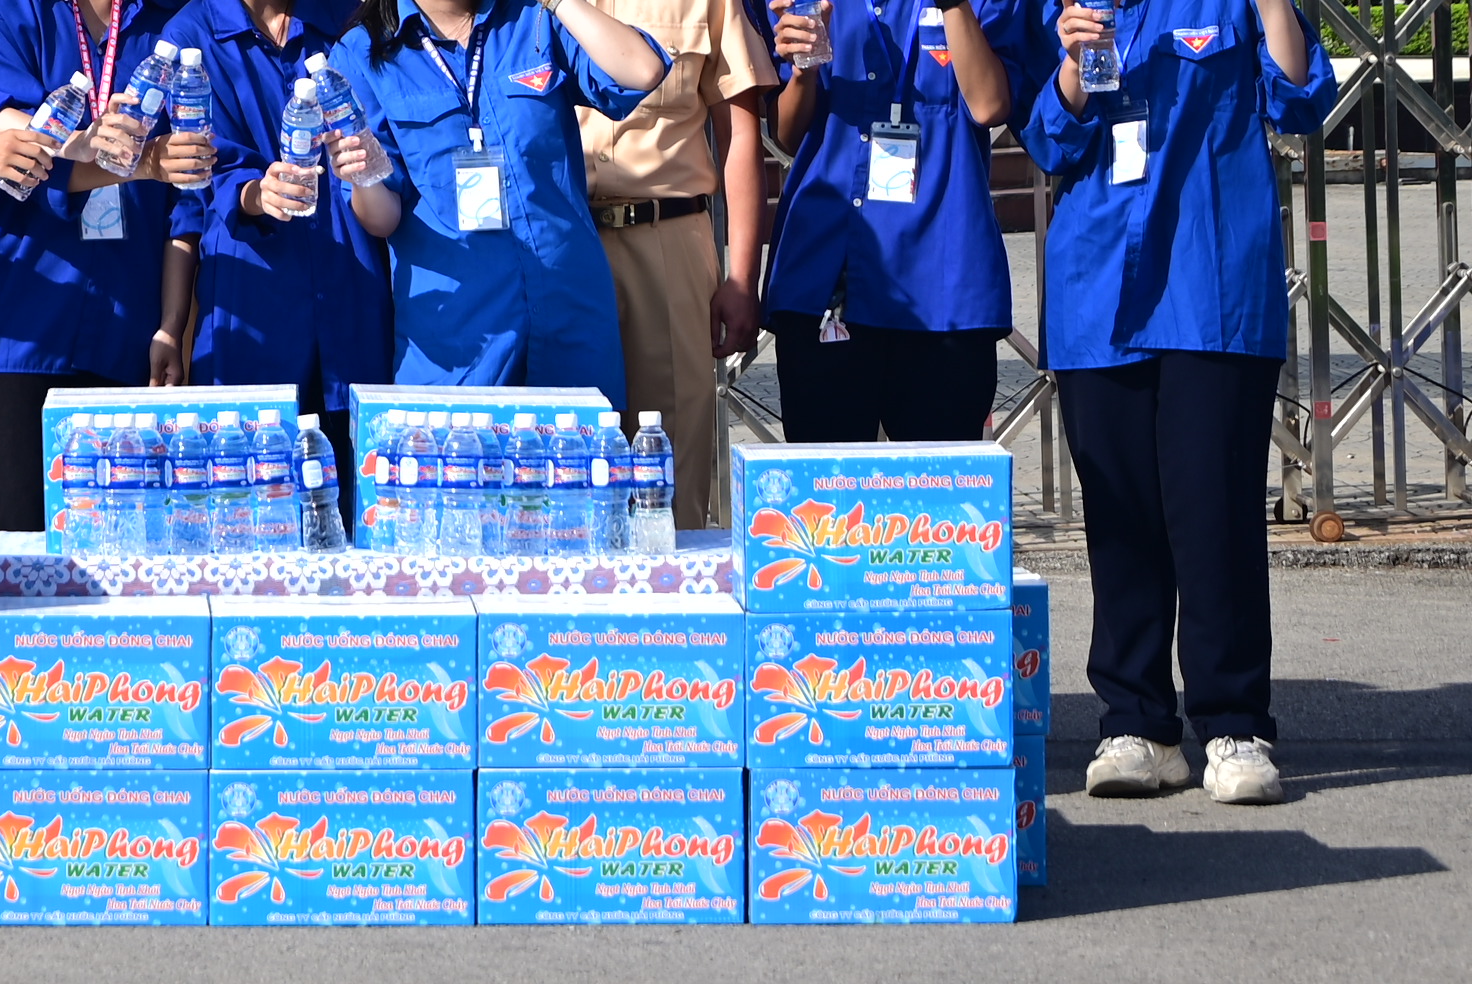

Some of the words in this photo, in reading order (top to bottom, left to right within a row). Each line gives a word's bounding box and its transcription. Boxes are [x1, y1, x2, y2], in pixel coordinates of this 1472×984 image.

[813, 474, 856, 490] NƯỚC
[860, 472, 903, 489] UỐNG
[908, 472, 951, 489] ĐÓNG
[956, 473, 992, 488] CHAI
[813, 513, 1002, 553] HaiPhong
[869, 548, 952, 565] WATER
[15, 631, 57, 647] NƯỚC
[61, 630, 104, 647] UỐNG
[109, 632, 152, 647] ĐÓNG
[156, 633, 192, 647] CHAI
[281, 632, 324, 648] NƯỚC
[327, 631, 370, 648] UỐNG
[375, 632, 418, 647] ĐÓNG
[422, 633, 459, 647] CHAI
[548, 629, 591, 645] NƯỚC
[595, 628, 638, 645] UỐNG
[643, 630, 686, 645] ĐÓNG
[690, 631, 726, 645] CHAI
[815, 629, 858, 645] NƯỚC
[862, 627, 905, 645] UỐNG
[910, 628, 953, 644] ĐÓNG
[957, 629, 994, 644] CHAI
[14, 673, 201, 710] HaiPhong
[280, 673, 467, 710] HaiPhong
[548, 671, 735, 708] HaiPhong
[815, 669, 1003, 708] HaiPhong
[68, 707, 151, 722] WATER
[335, 707, 418, 722] WATER
[602, 705, 685, 720] WATER
[870, 704, 954, 720] WATER
[13, 787, 56, 803] NƯỚC
[59, 786, 102, 803] UỐNG
[107, 788, 150, 803] ĐÓNG
[154, 789, 190, 803] CHAI
[278, 788, 321, 804] NƯỚC
[324, 787, 367, 804] UỐNG
[372, 788, 415, 803] ĐÓNG
[419, 789, 456, 803] CHAI
[547, 786, 589, 802] NƯỚC
[593, 785, 636, 802] UỐNG
[641, 786, 684, 802] ĐÓNG
[688, 787, 725, 801] CHAI
[821, 785, 863, 801] NƯỚC
[867, 784, 910, 801] UỐNG
[915, 785, 958, 801] ĐÓNG
[963, 786, 999, 800] CHAI
[12, 829, 199, 866] HaiPhong
[277, 829, 464, 867] HaiPhong
[546, 827, 733, 865] HaiPhong
[820, 826, 1007, 864] HaiPhong
[66, 863, 149, 878] WATER
[332, 863, 415, 878] WATER
[601, 861, 684, 877] WATER
[875, 860, 958, 876] WATER
